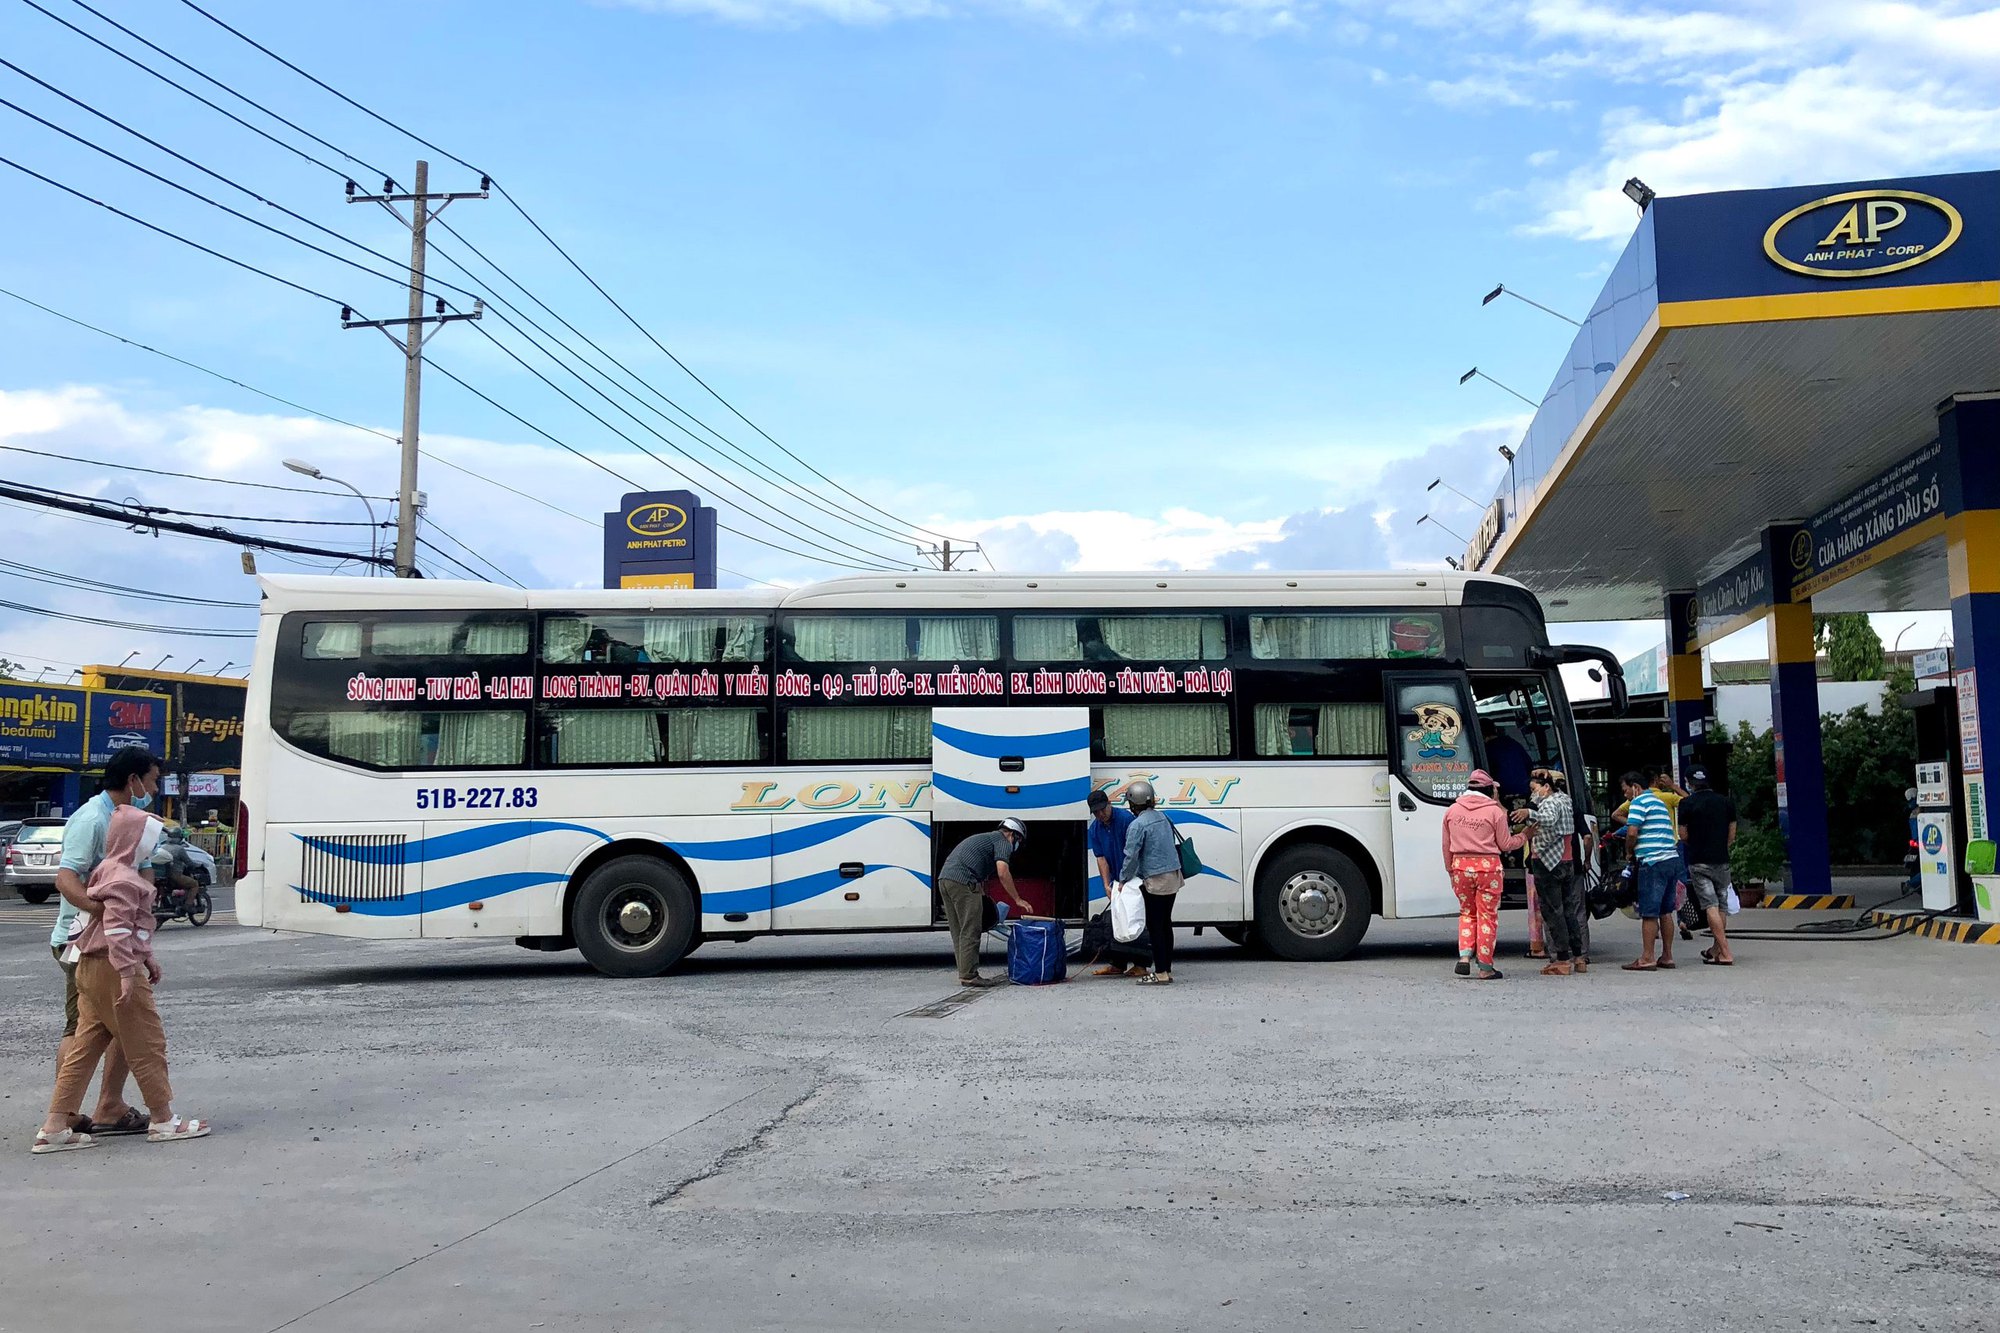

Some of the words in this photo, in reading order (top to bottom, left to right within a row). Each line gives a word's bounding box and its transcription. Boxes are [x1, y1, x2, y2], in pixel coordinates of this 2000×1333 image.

[1817, 200, 1907, 246] AP
[1804, 250, 1833, 263] ANH
[1836, 248, 1875, 260] PHAT
[1886, 244, 1924, 257] CORP
[645, 508, 669, 523] AP
[1818, 537, 1837, 567] CỬA
[1837, 526, 1864, 558] HÀNG
[1865, 506, 1895, 544] XĂNG
[1897, 491, 1920, 526] DẦU
[1922, 472, 1940, 514] SỐ
[627, 541, 643, 549] ANH
[643, 540, 662, 549] PHAT
[662, 538, 687, 548] PETRO
[347, 672, 382, 701] SÔNG
[383, 678, 416, 701] HINH
[425, 678, 453, 700] TUY
[454, 671, 481, 700] HOÀ
[510, 676, 533, 699] HAI
[543, 675, 577, 698] LONG
[578, 671, 622, 698] THÀNH
[655, 668, 690, 700] QUÂN
[692, 668, 718, 696] DÂN
[724, 673, 734, 696] Y
[736, 665, 768, 696] MIỀN
[776, 668, 811, 697] ĐÔNG
[822, 673, 843, 700] Q.9
[852, 666, 878, 697] THỦ
[937, 664, 968, 695] MIỀN
[969, 667, 1003, 695] ĐÔNG
[1011, 672, 1032, 694] BX.
[1033, 667, 1063, 694] BÌNH
[1066, 668, 1106, 694] DƯƠNG
[1116, 666, 1141, 693] TÂN
[1143, 666, 1175, 693] UYÊN
[1184, 666, 1210, 693] HOÀ
[1211, 667, 1233, 697] LỢI
[0, 694, 77, 726] ngkim
[109, 701, 151, 730] 3M
[1411, 762, 1442, 773] LONG
[416, 787, 538, 809] 51B-227.83
[730, 779, 932, 811] LON
[1432, 783, 1450, 791] 0965
[1926, 826, 1938, 844] AP
